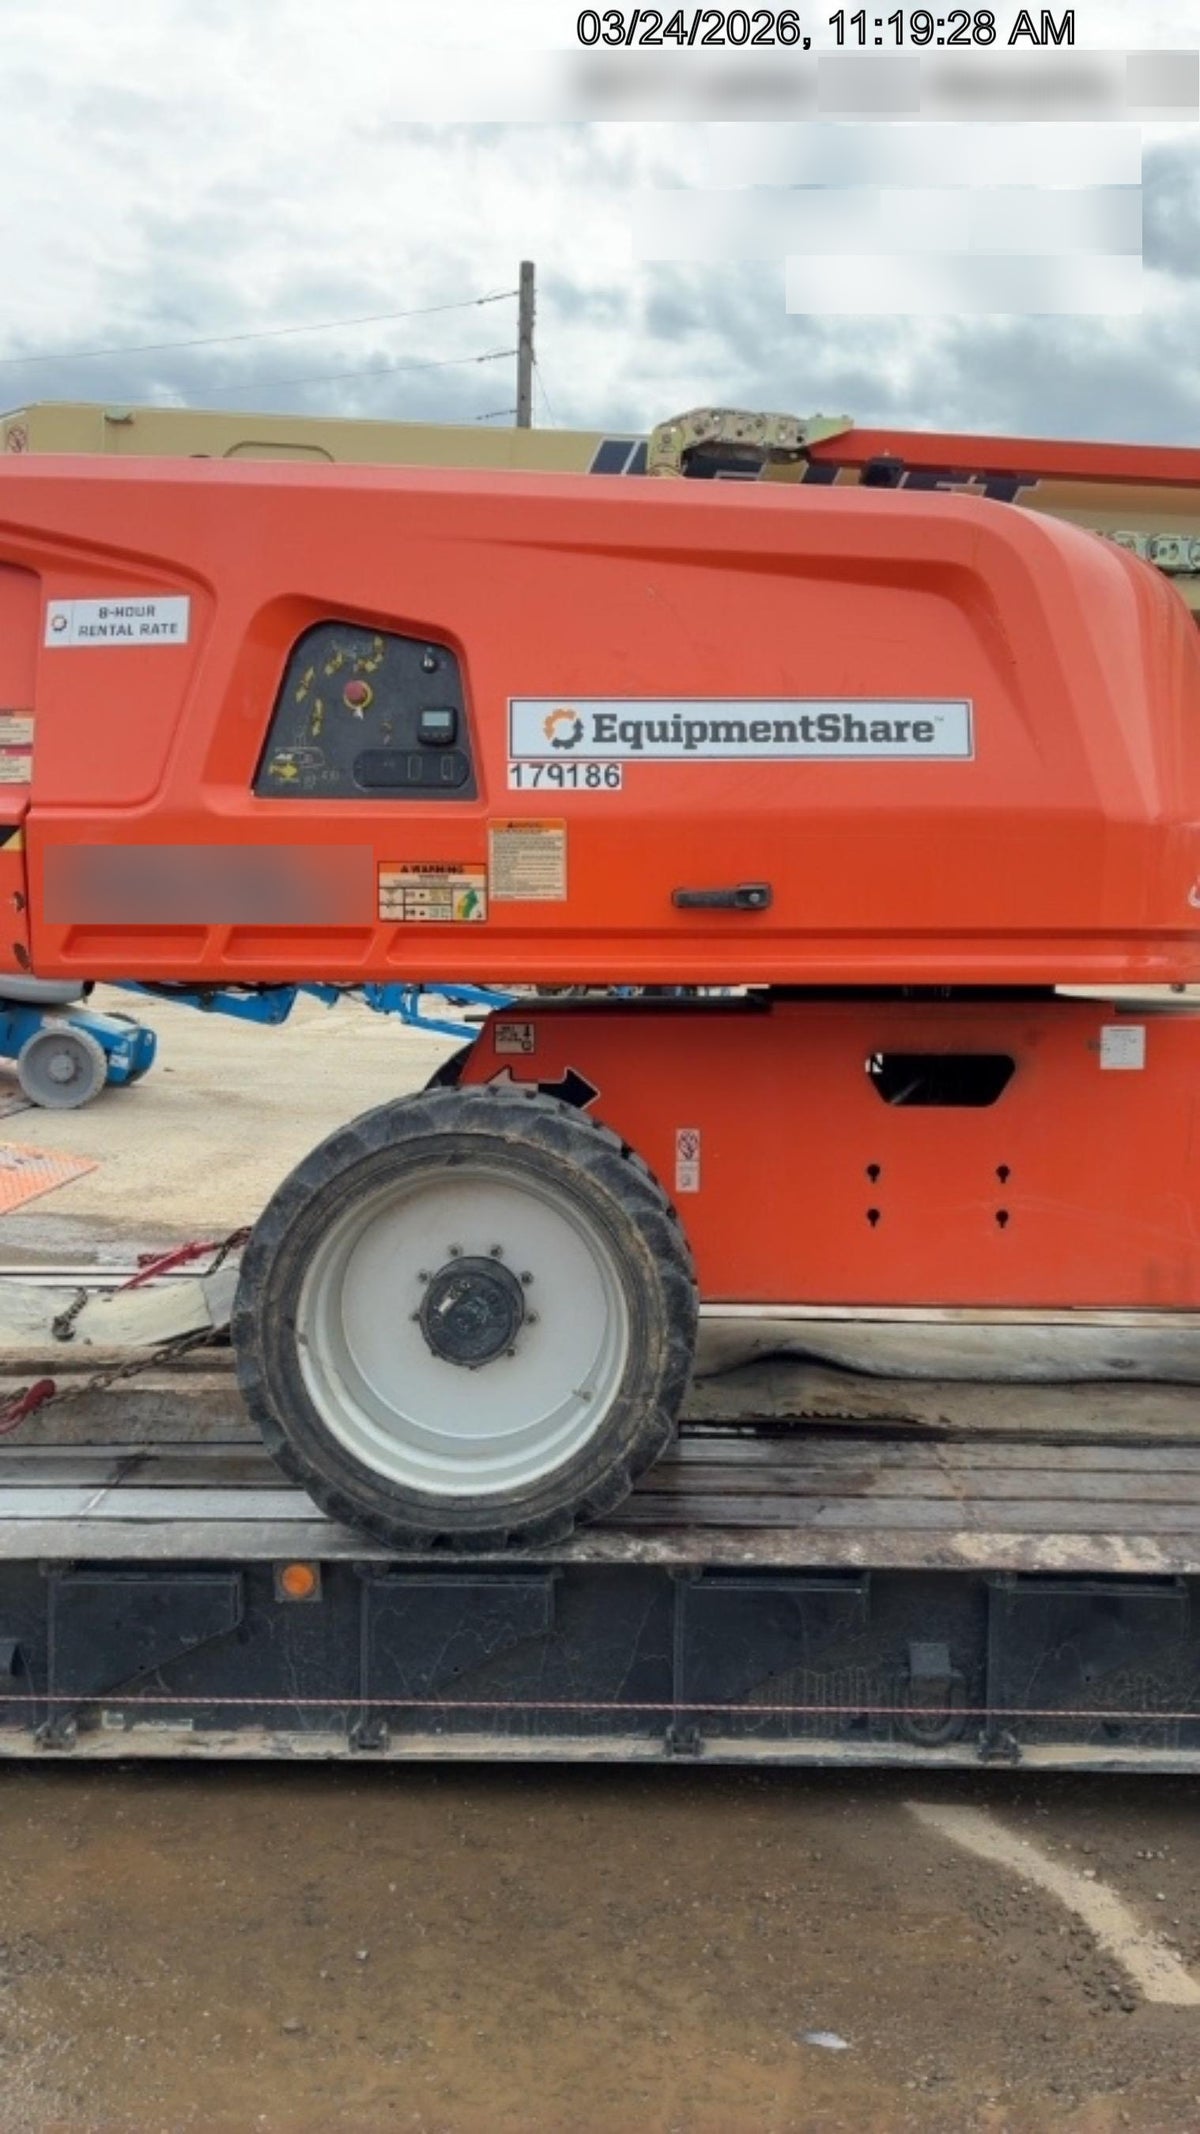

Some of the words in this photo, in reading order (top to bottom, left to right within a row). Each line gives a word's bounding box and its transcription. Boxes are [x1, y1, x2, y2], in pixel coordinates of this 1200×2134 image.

[98, 605, 156, 619] 8-HOUR
[79, 625, 134, 636] RENTAL
[140, 623, 178, 635] RATE
[592, 713, 935, 750] EquipmentShare
[510, 764, 620, 788] 179186
